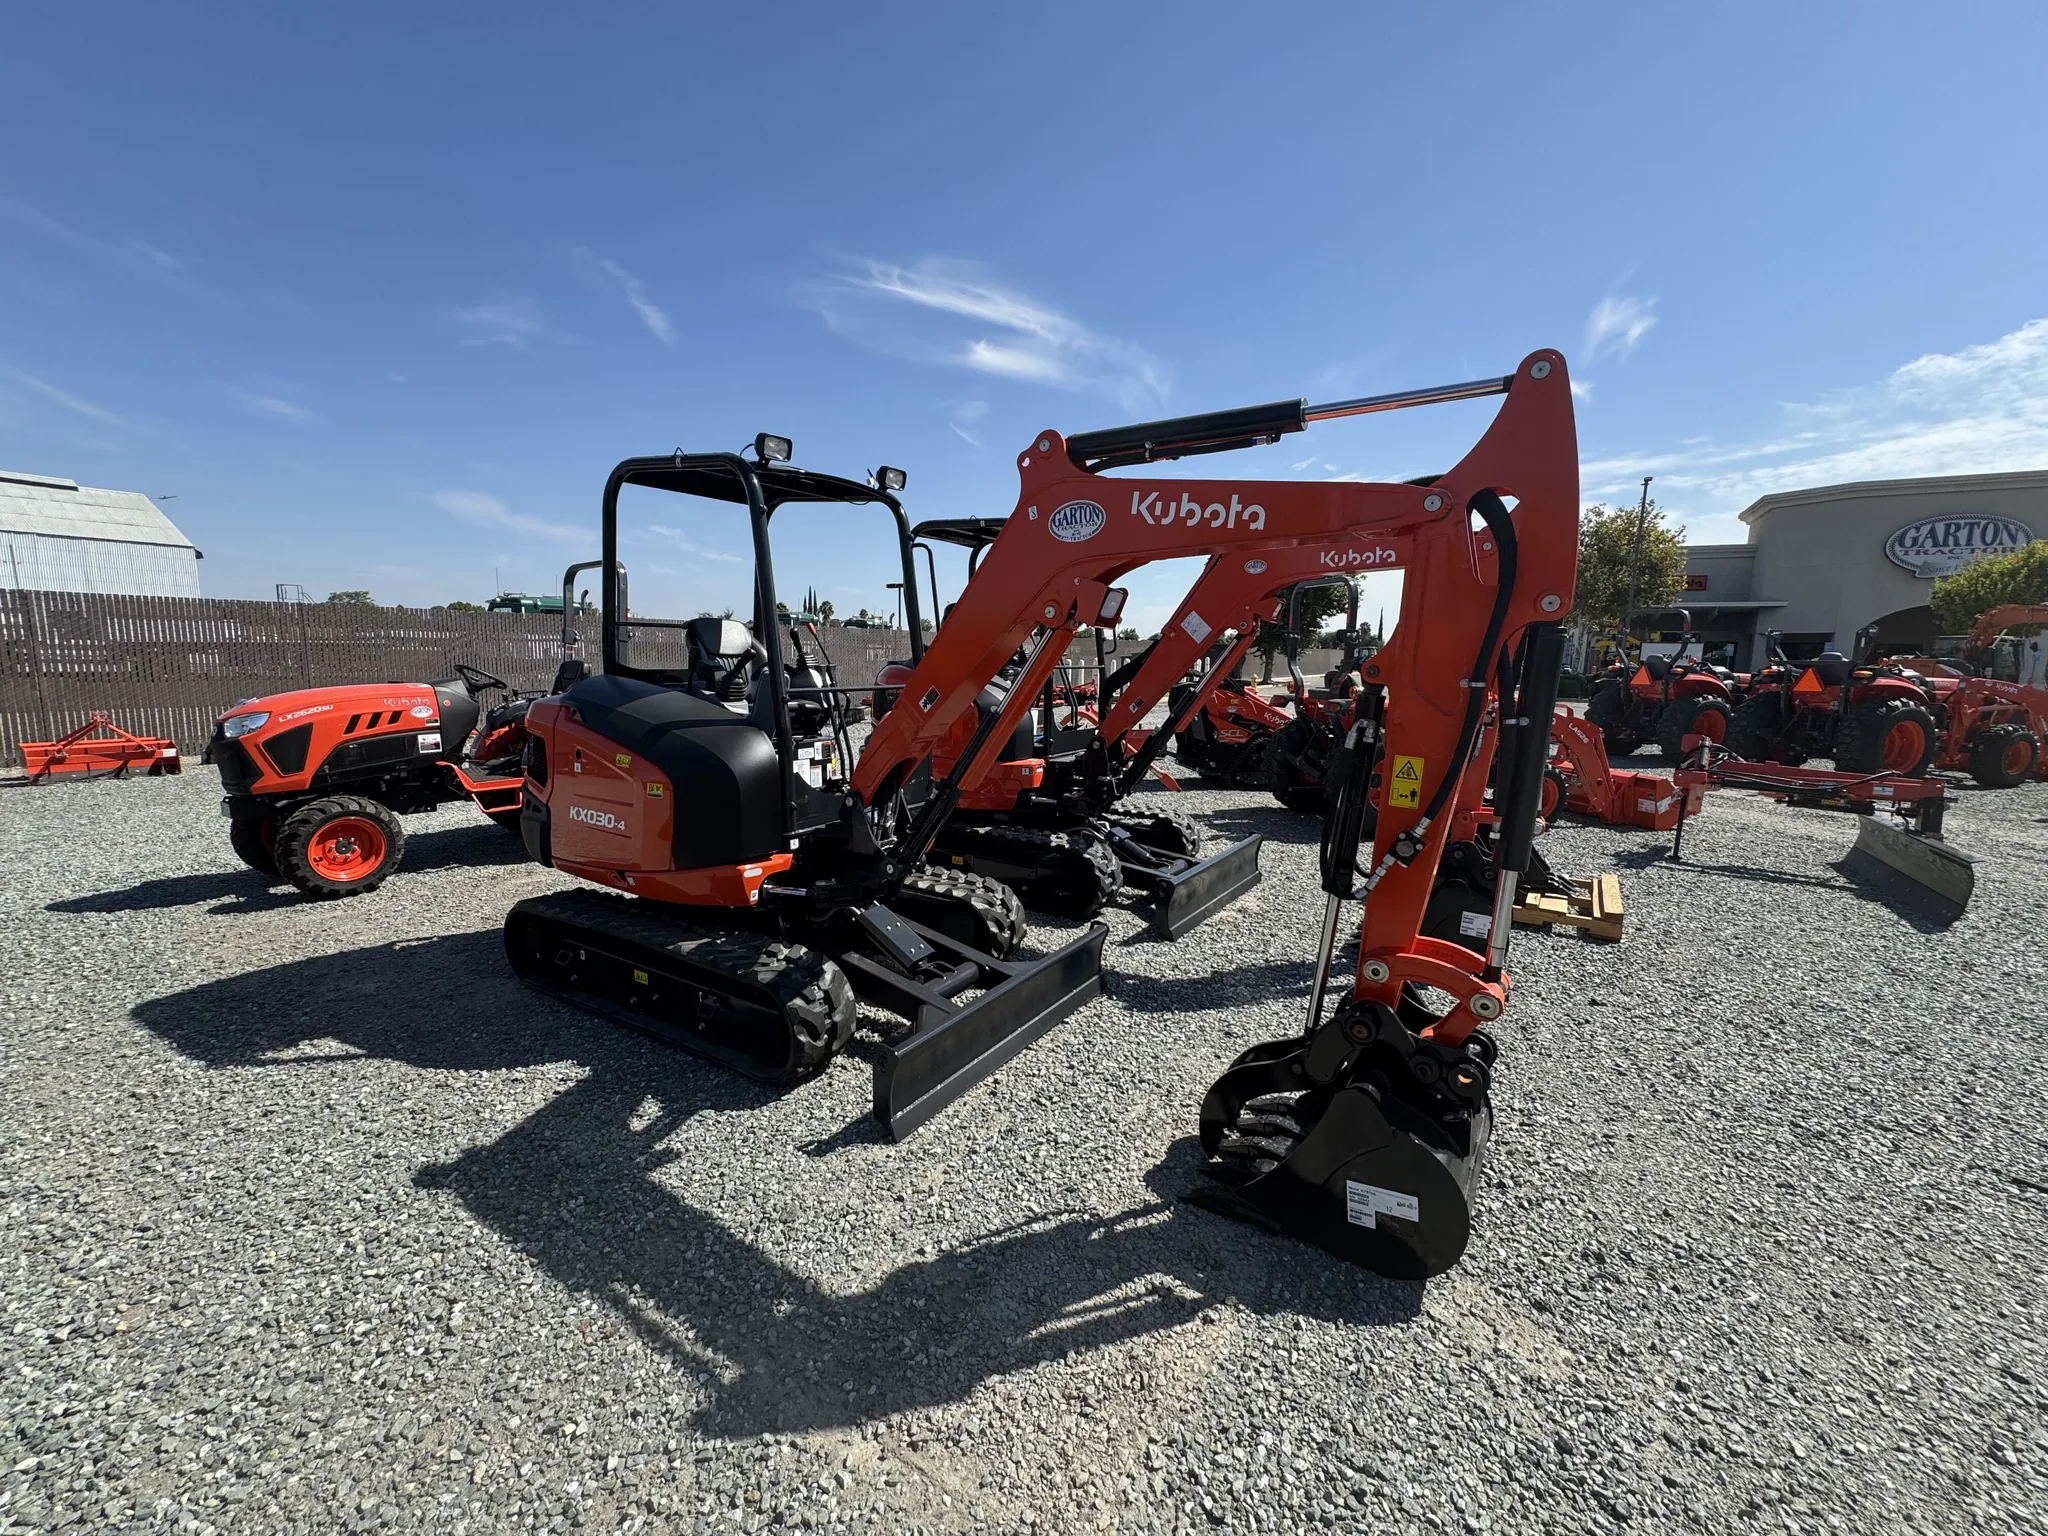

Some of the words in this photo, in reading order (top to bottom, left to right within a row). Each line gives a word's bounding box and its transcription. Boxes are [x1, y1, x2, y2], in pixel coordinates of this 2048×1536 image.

[1052, 505, 1100, 528] GARTON
[1131, 491, 1266, 530] Kubota
[1056, 521, 1098, 532] TRACTOR
[1899, 521, 2020, 549] GARTON
[1320, 547, 1396, 567] Kubota
[1900, 548, 2016, 556] TRACTOR
[383, 697, 430, 707] Kubota
[279, 704, 334, 723] LX2620SU
[1220, 729, 1243, 737] SCL
[1568, 722, 1590, 744] LA526
[569, 806, 626, 831] KX030-4
